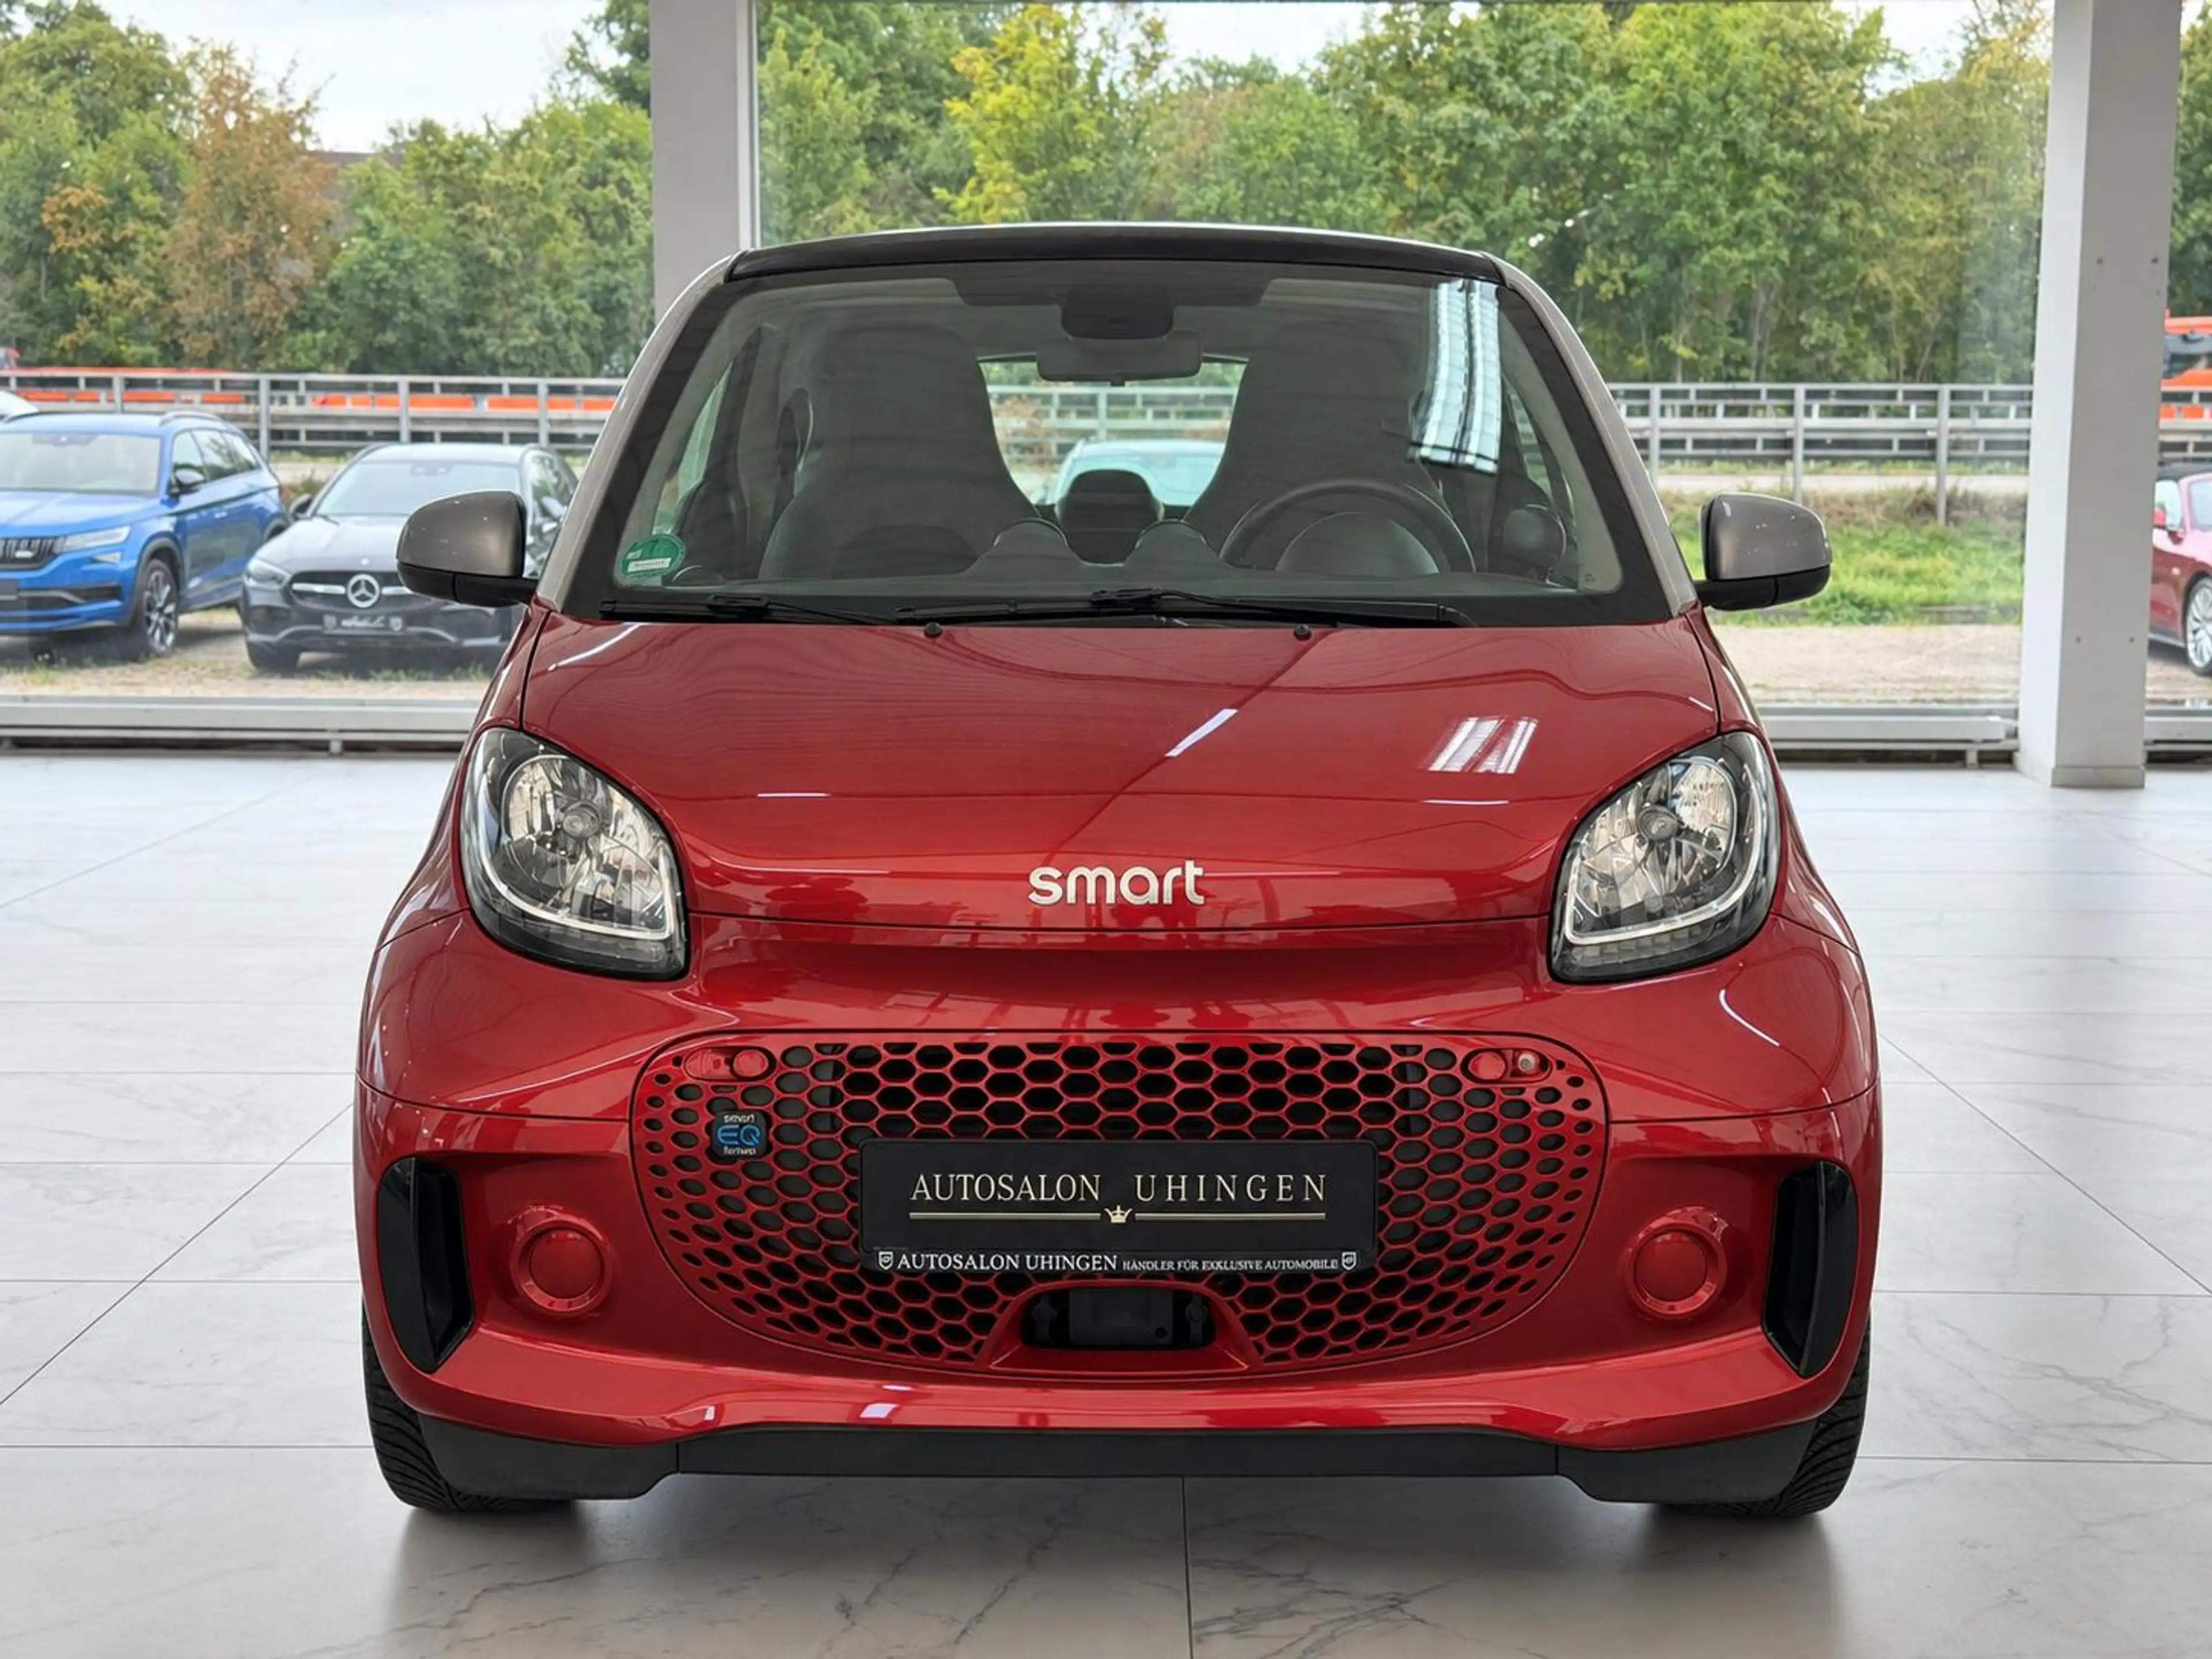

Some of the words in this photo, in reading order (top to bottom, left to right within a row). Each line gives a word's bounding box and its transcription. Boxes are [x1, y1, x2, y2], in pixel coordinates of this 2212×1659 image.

[1028, 860, 1205, 904] smart
[717, 1124, 760, 1146] EQ
[910, 1174, 1101, 1201] AUTOSALON
[1135, 1175, 1325, 1201] UHINGEN
[897, 1254, 1020, 1271] AUTOSALON
[1025, 1254, 1118, 1271] UHINGEN
[1202, 1259, 1263, 1271] EXKLUSIVE
[1264, 1259, 1339, 1270] AUTOMOBILE
